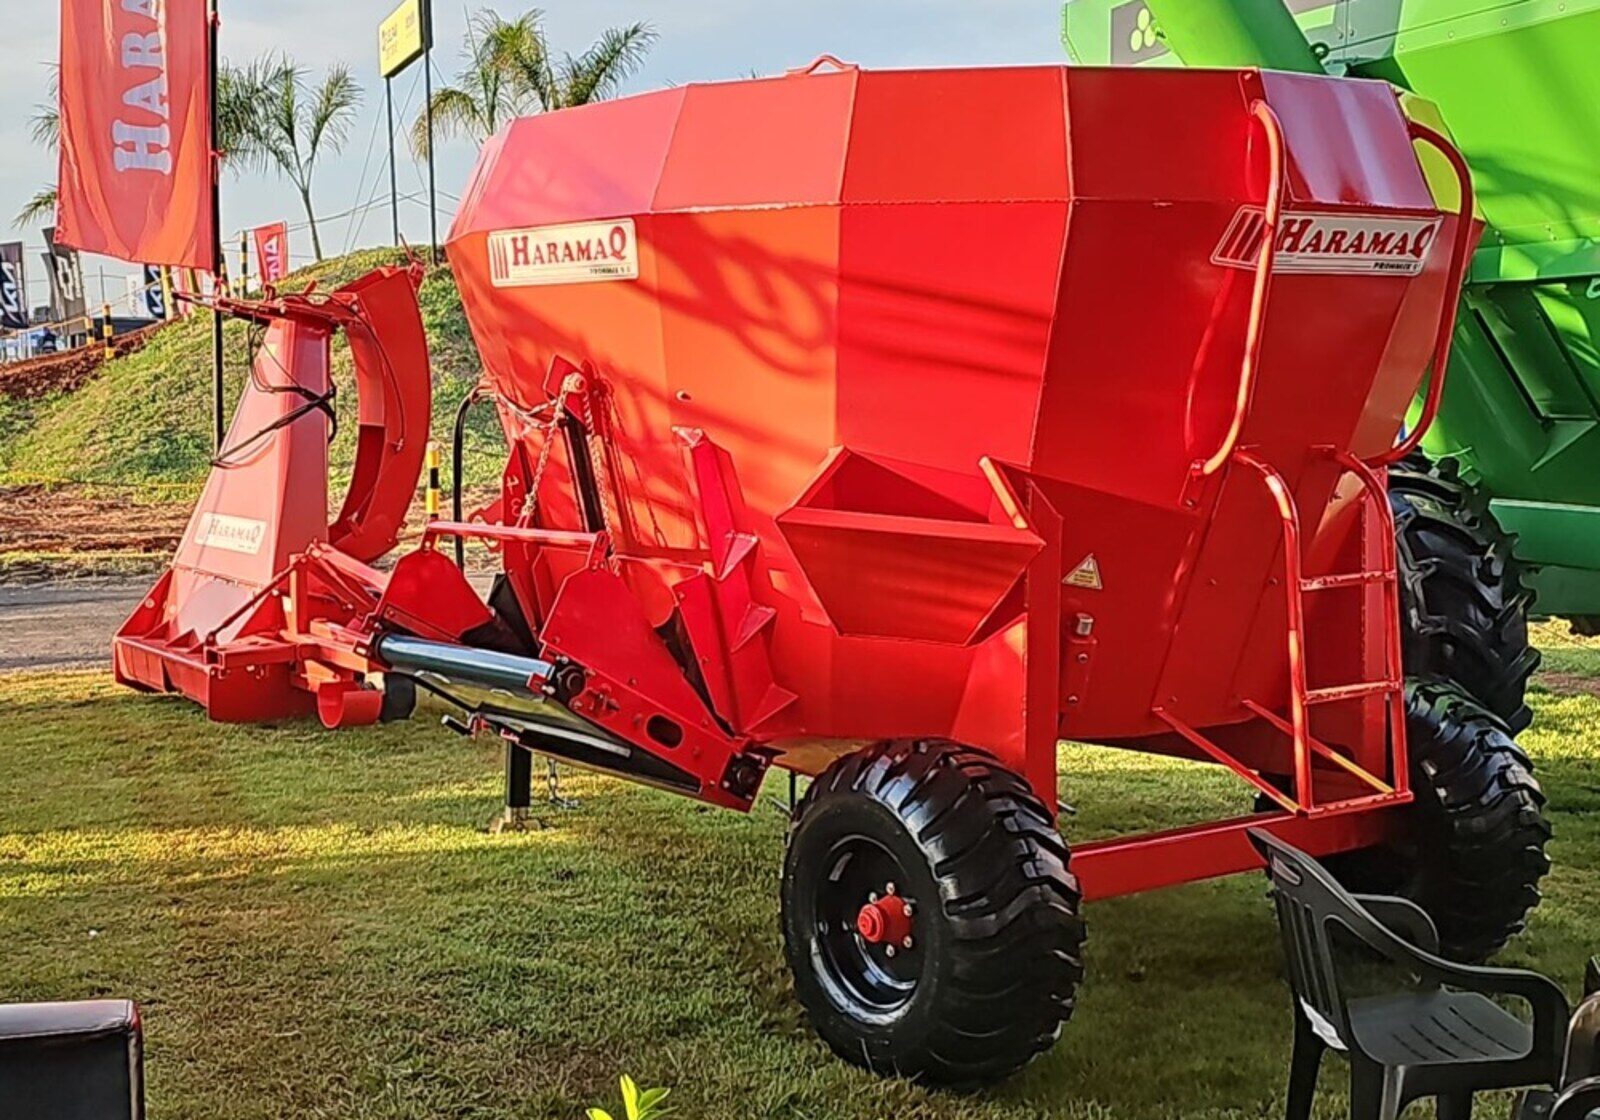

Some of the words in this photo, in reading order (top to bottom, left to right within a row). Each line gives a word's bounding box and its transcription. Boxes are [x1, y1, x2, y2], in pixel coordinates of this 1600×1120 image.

[510, 225, 627, 266] HARAMAQ
[1276, 218, 1436, 258] HARAMAQ
[208, 517, 261, 544] HARAMAQ
